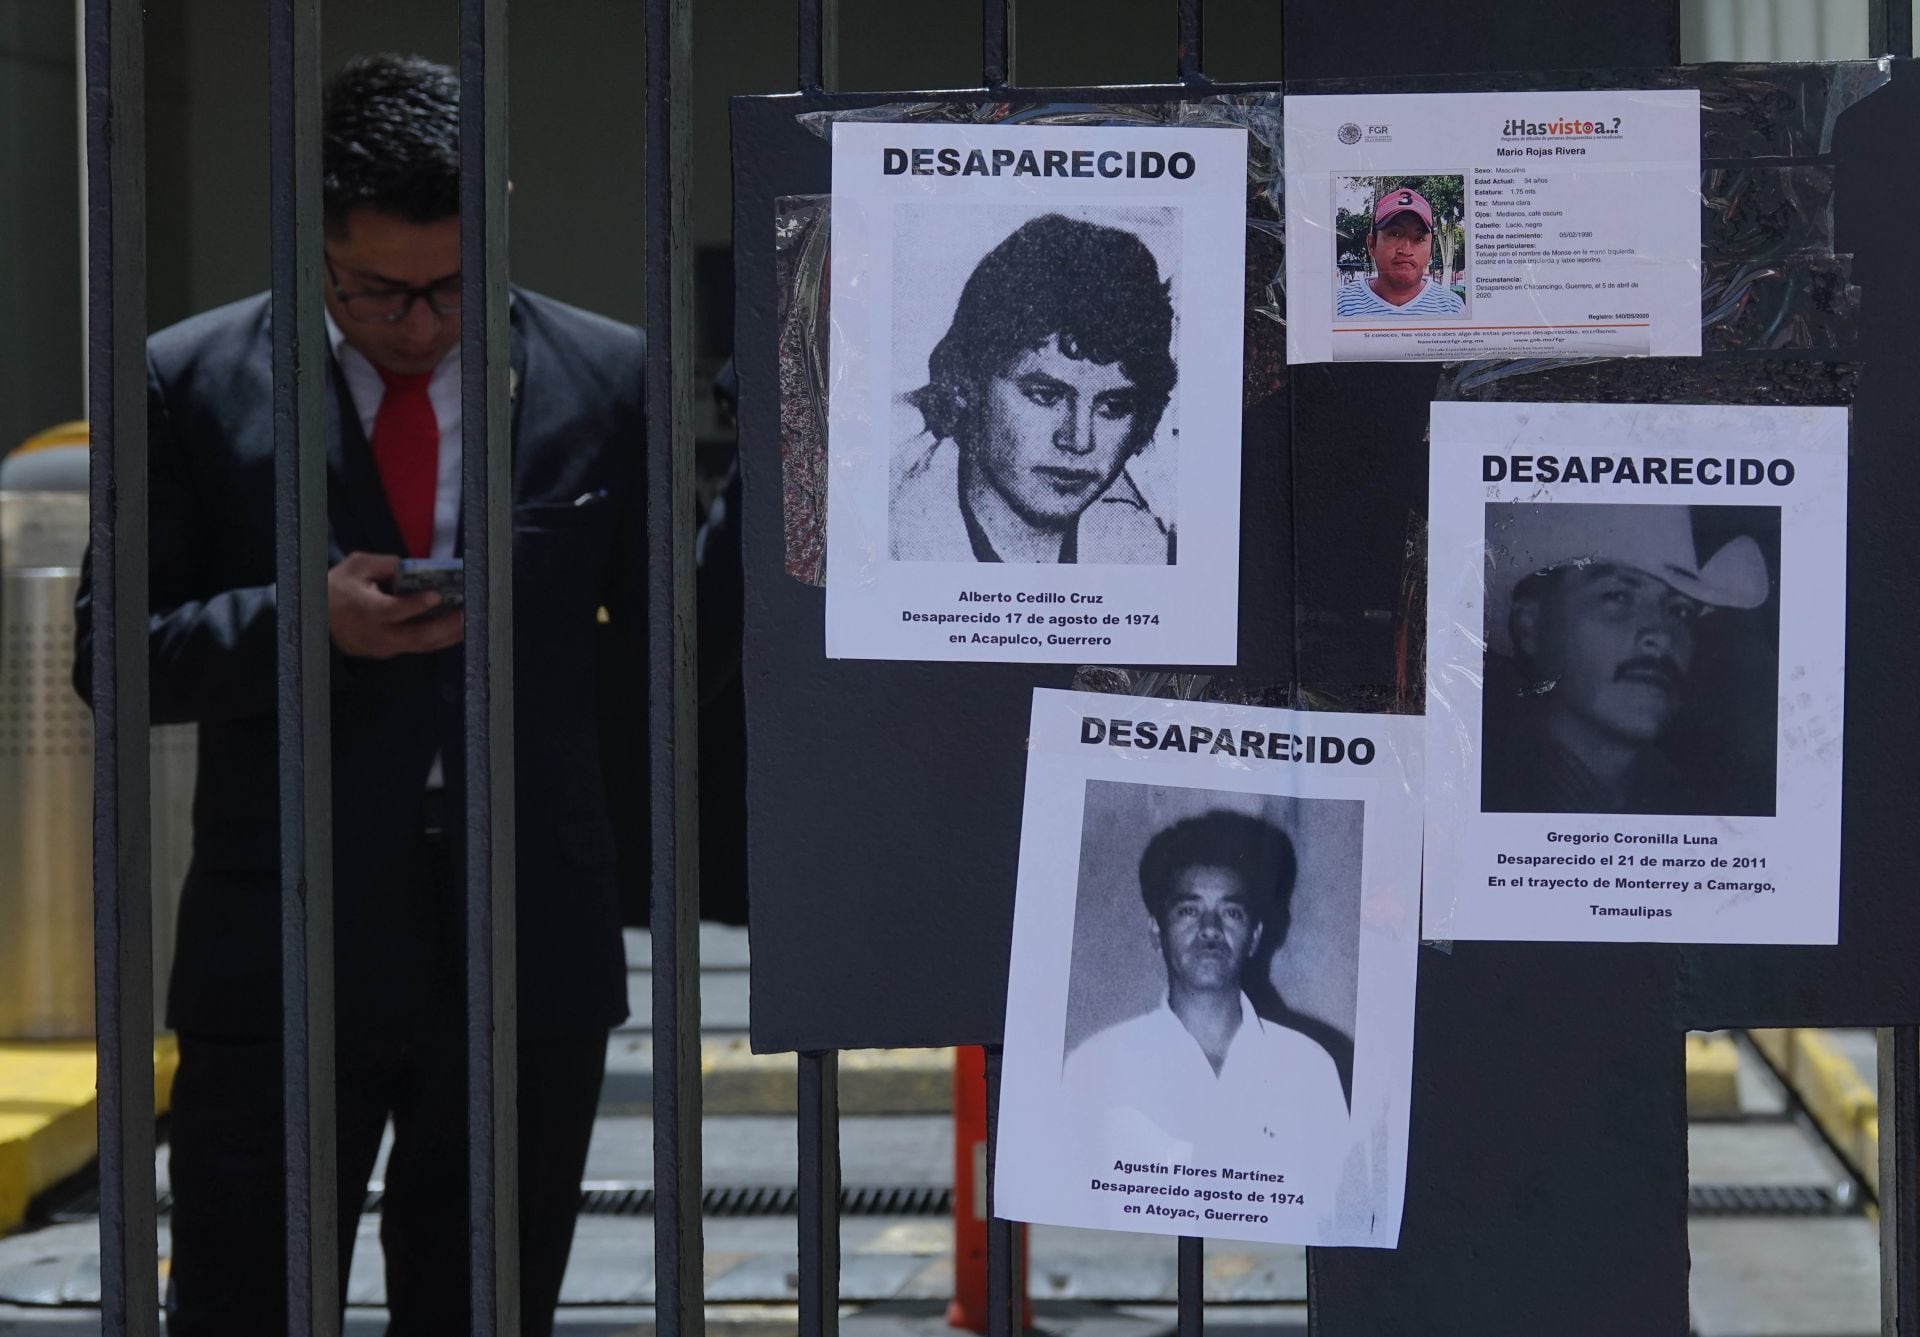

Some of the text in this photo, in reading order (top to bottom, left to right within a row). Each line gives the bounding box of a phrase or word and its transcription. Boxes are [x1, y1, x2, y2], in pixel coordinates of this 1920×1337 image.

[1368, 126, 1388, 134] FGR
[1497, 146, 1586, 157] Mario Rojas Rivera
[883, 148, 1196, 180] DESAPARECIDO
[1398, 191, 1413, 206] 3
[1475, 211, 1492, 219] Ojos:
[1482, 455, 1795, 486] DESAPARECIDO
[958, 590, 1104, 605] Alberto Cedillo Cruz
[901, 611, 1160, 628] Desaparecido 17 de agosto de 1974
[949, 632, 1112, 648] en Acapulco, Guerrero
[1080, 716, 1376, 766] DESAPARECIDO
[1546, 831, 1718, 846] Gregorio Coronilla Luna
[1496, 853, 1767, 869] Desaparecido el 21 de marzo de 2011
[1487, 876, 1776, 894] En el trayecto de Monterrey a Camargo,
[1589, 904, 1673, 919] Tamaulipas
[1113, 1160, 1285, 1184] Agustín Flores Martínez
[1091, 1179, 1305, 1206] Desaparecido agosto de 1974
[1123, 1204, 1269, 1224] en Atoyac, Guerrero
